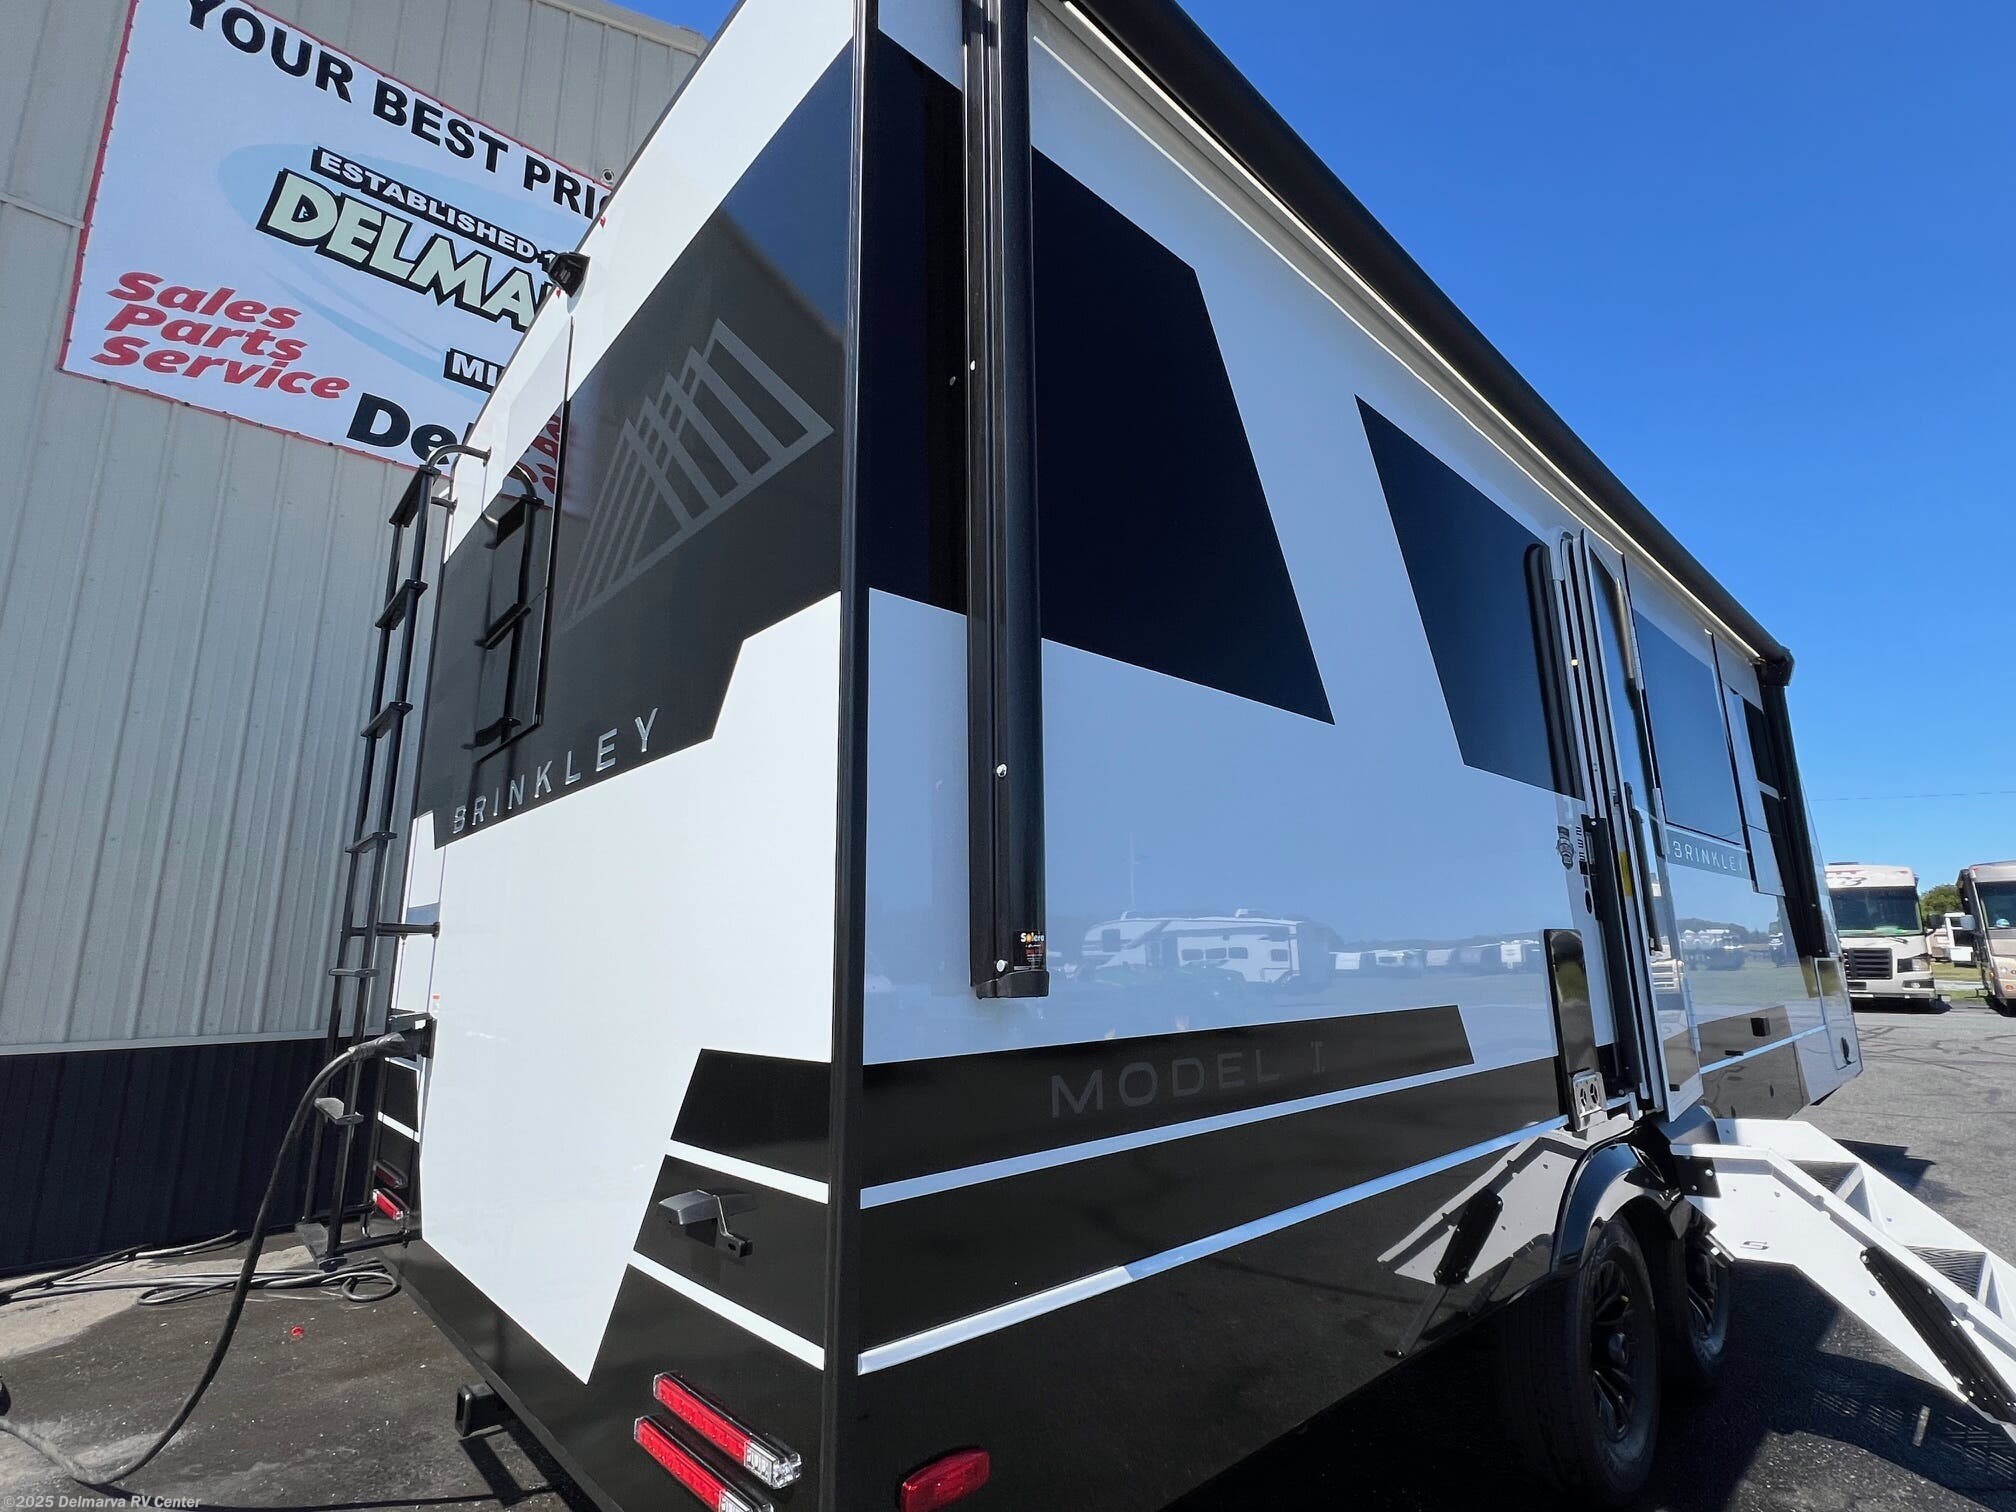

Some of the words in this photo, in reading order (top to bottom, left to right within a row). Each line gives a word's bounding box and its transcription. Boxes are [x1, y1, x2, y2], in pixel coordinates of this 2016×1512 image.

[188, 0, 353, 103] YOUR
[373, 79, 508, 173] BEST
[523, 155, 609, 219] PRI
[319, 150, 537, 258] ESTABLISHED
[262, 170, 553, 331] DELMA
[104, 303, 308, 361] Parts
[106, 271, 302, 329] Sales
[90, 336, 350, 399] Service
[452, 708, 659, 834] BRINKLEY
[1051, 1050, 1280, 1118] MODEL
